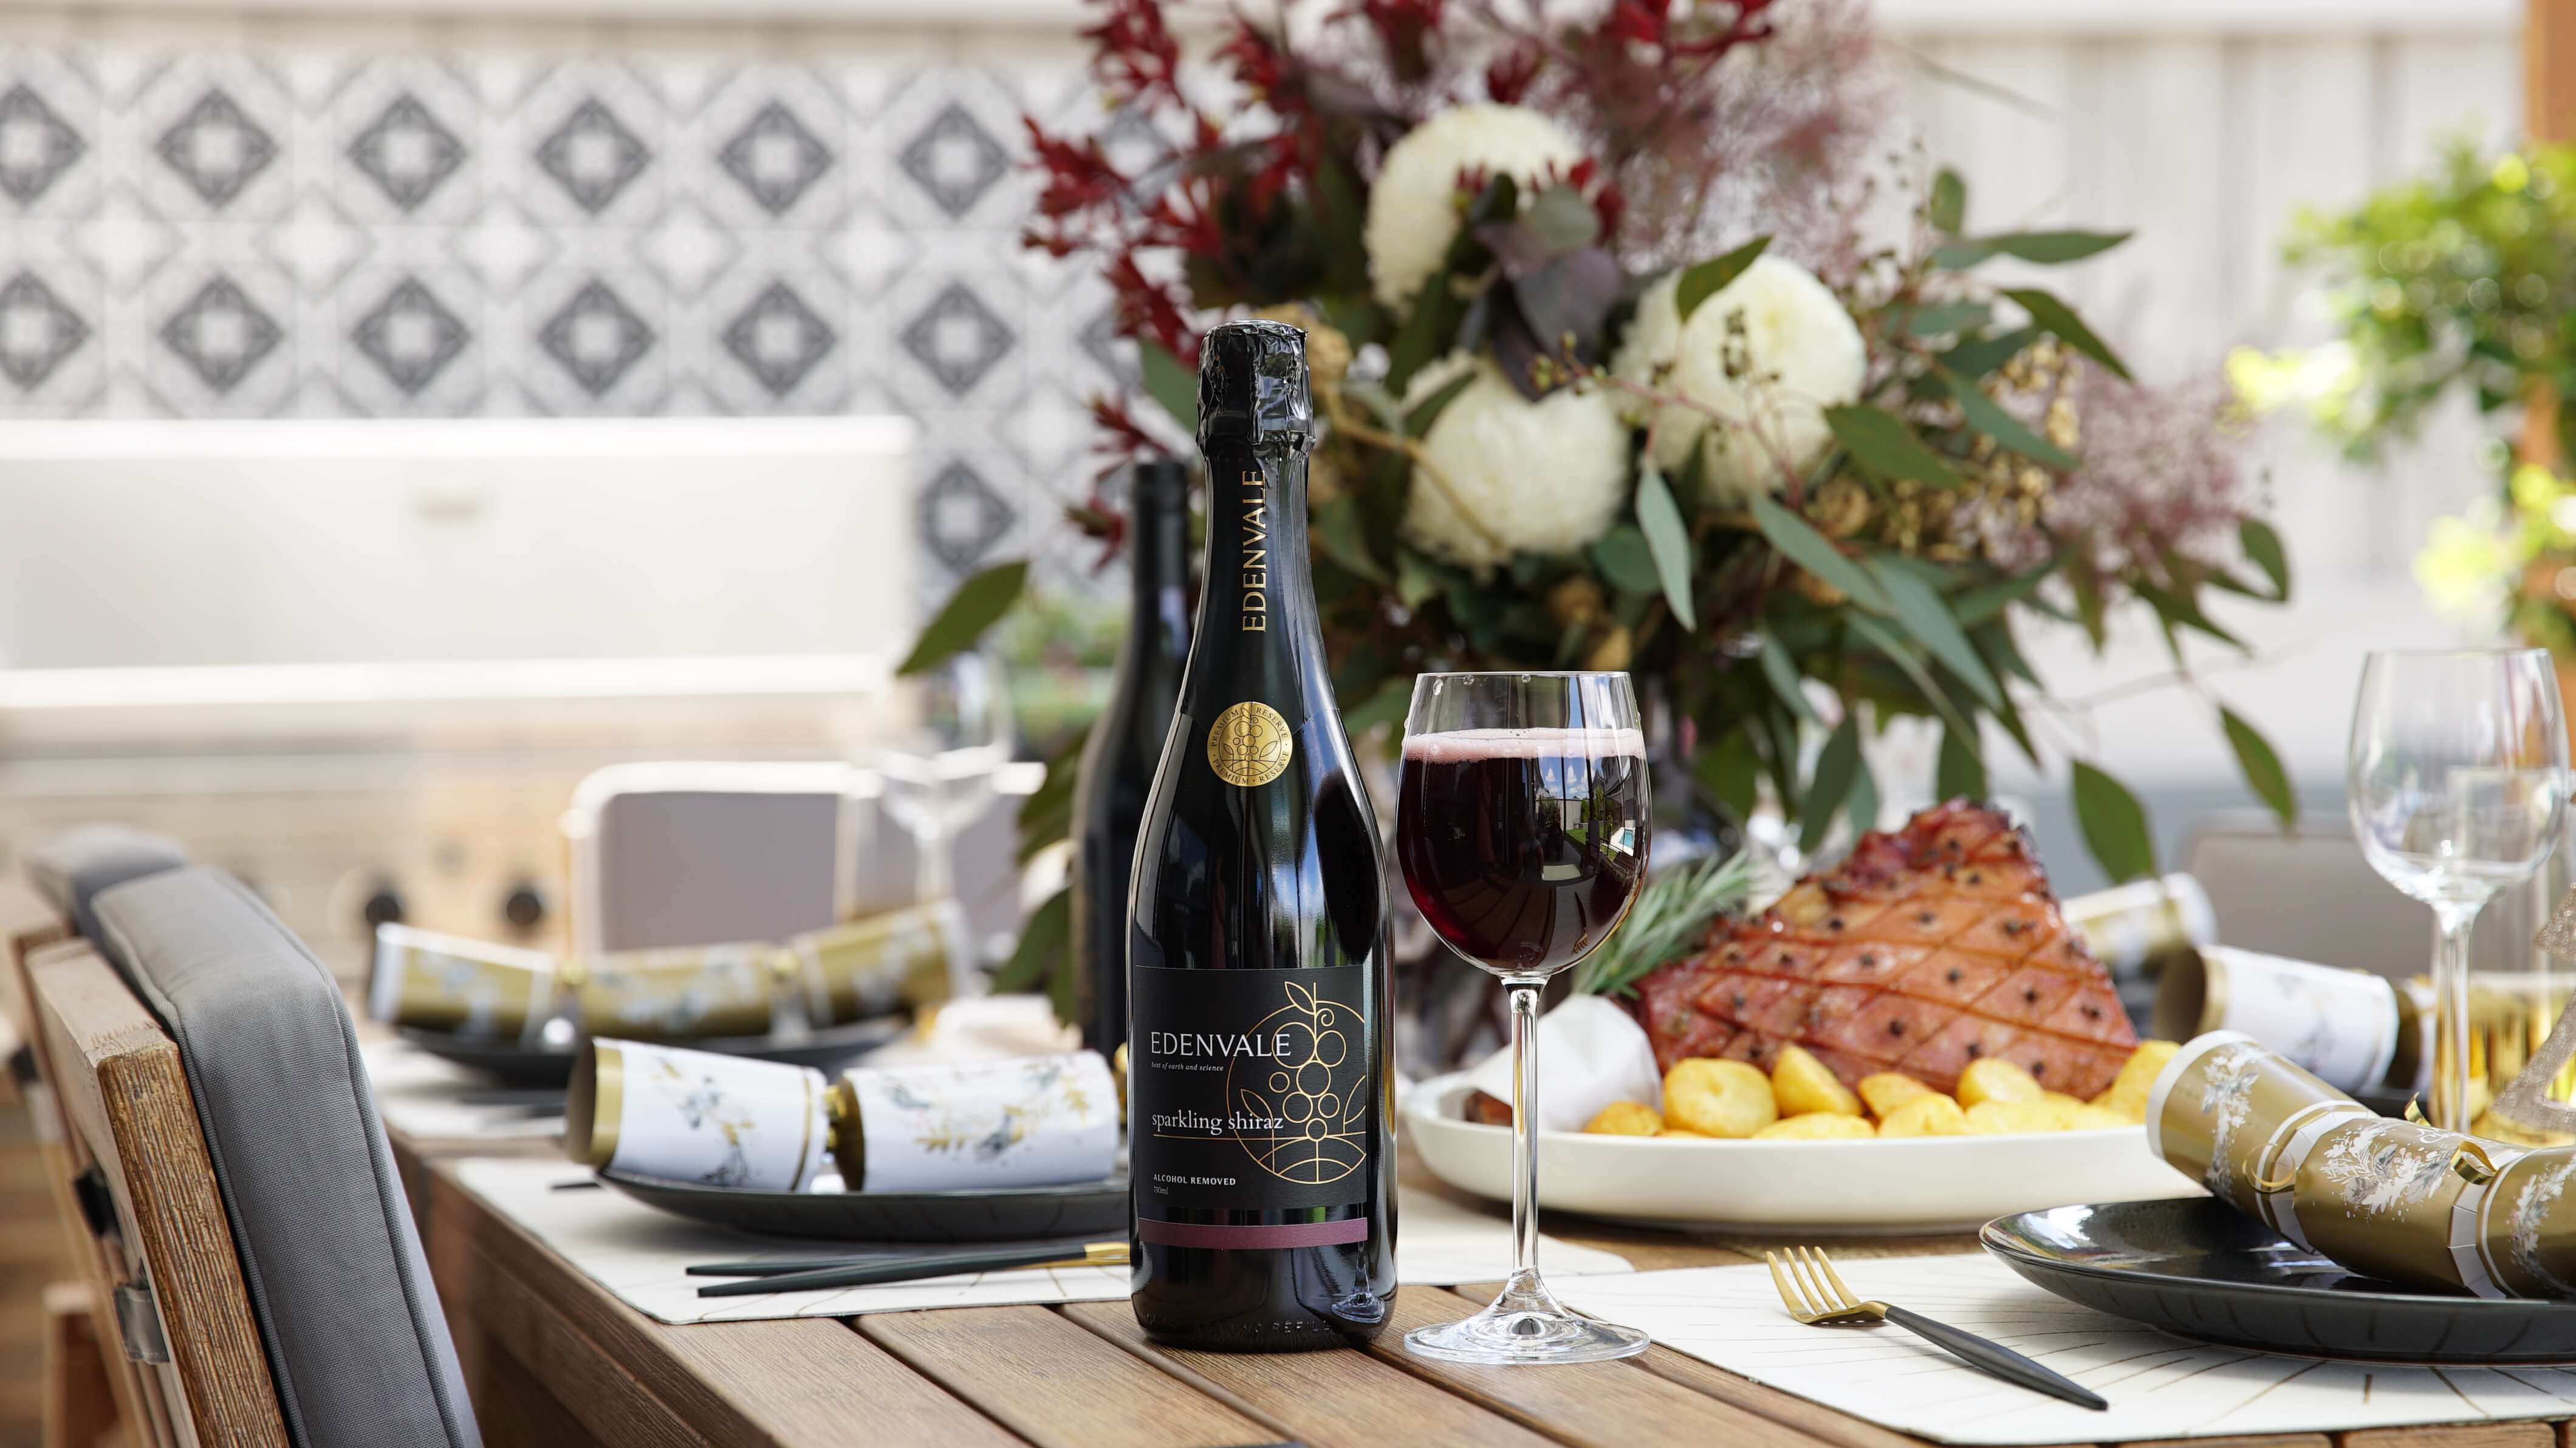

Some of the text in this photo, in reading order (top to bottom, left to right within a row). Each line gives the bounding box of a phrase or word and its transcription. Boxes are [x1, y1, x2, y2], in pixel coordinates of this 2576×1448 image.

[1242, 470, 1267, 632] EDENVALE
[1211, 707, 1289, 747] PREMIUM RESERVE
[1213, 751, 1289, 785] PREMIUM RESERVE
[1151, 1031, 1292, 1058] EDENVALE
[1162, 1062, 1168, 1070] of
[1151, 1109, 1284, 1136] sparkling shiraz
[1153, 1173, 1236, 1186] ALCOHOL REMOVED
